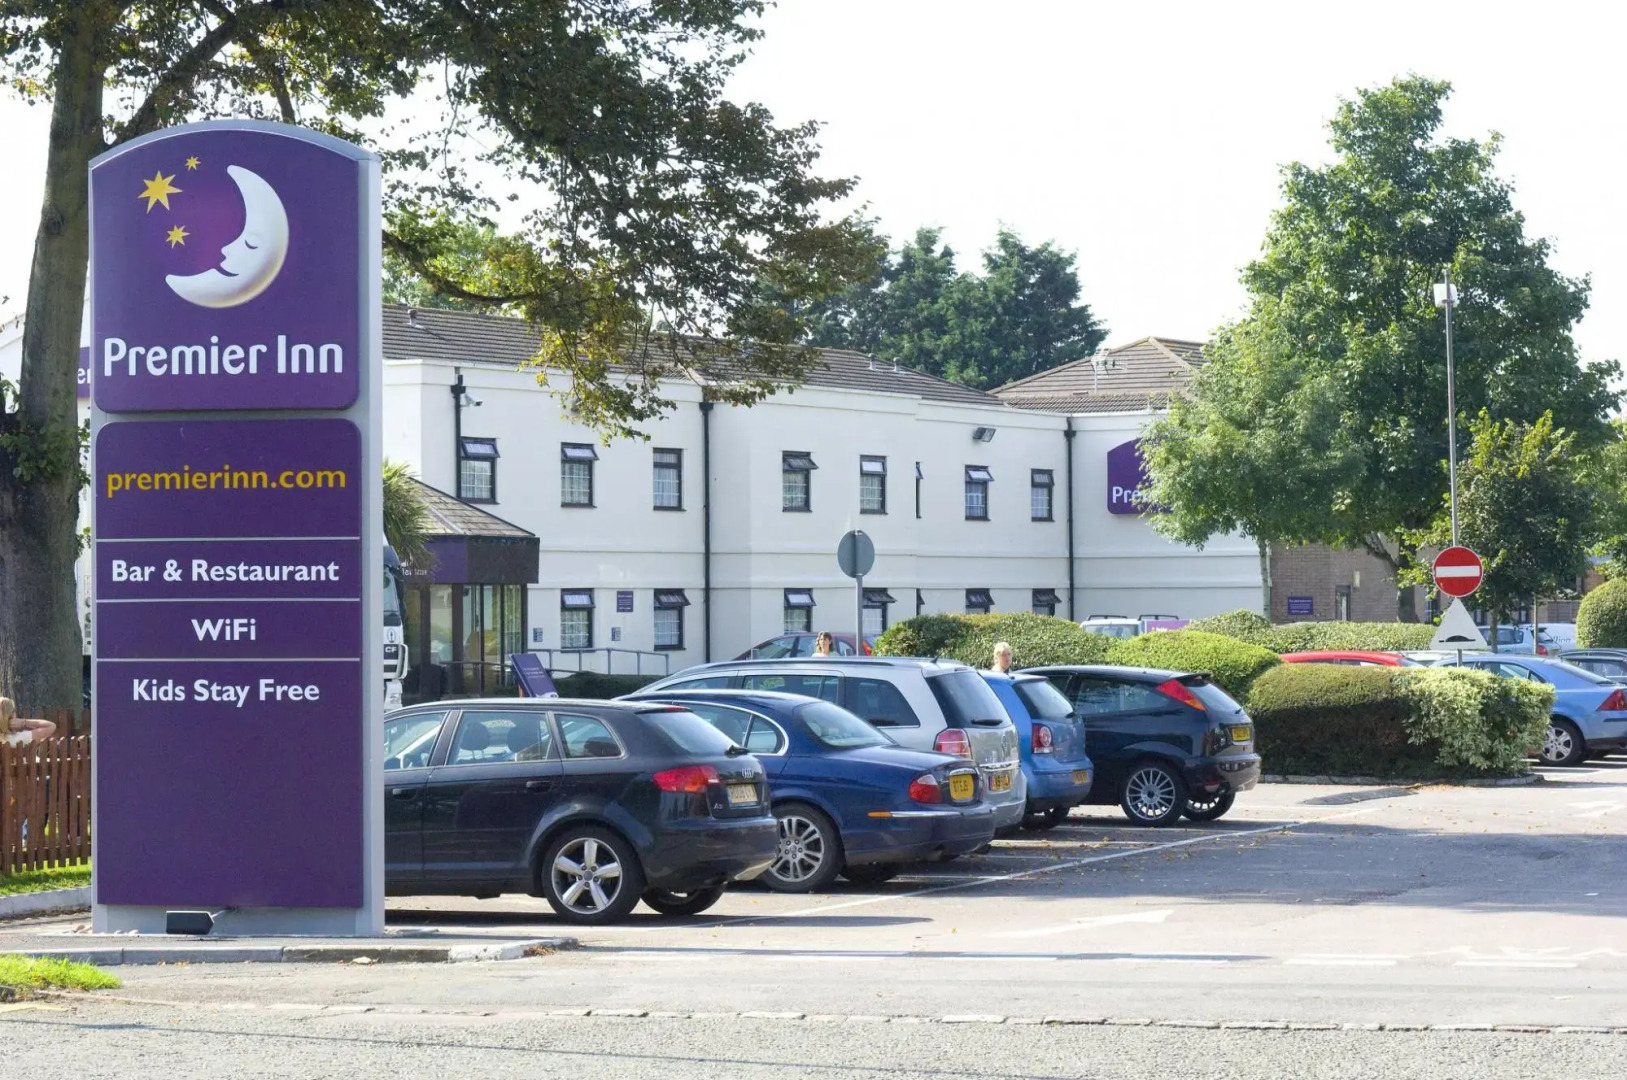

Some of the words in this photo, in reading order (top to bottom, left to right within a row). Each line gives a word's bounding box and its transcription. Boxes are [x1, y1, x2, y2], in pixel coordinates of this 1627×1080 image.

[104, 336, 267, 376] Premier
[277, 335, 343, 374] Inn
[106, 464, 346, 498] premierinn.com
[112, 560, 155, 582] Bar
[163, 559, 182, 581] &
[192, 559, 339, 581] Restaurant
[191, 618, 256, 641] WiFi
[133, 679, 185, 701] Kids
[194, 680, 250, 708] Stay
[259, 679, 320, 701] Free
